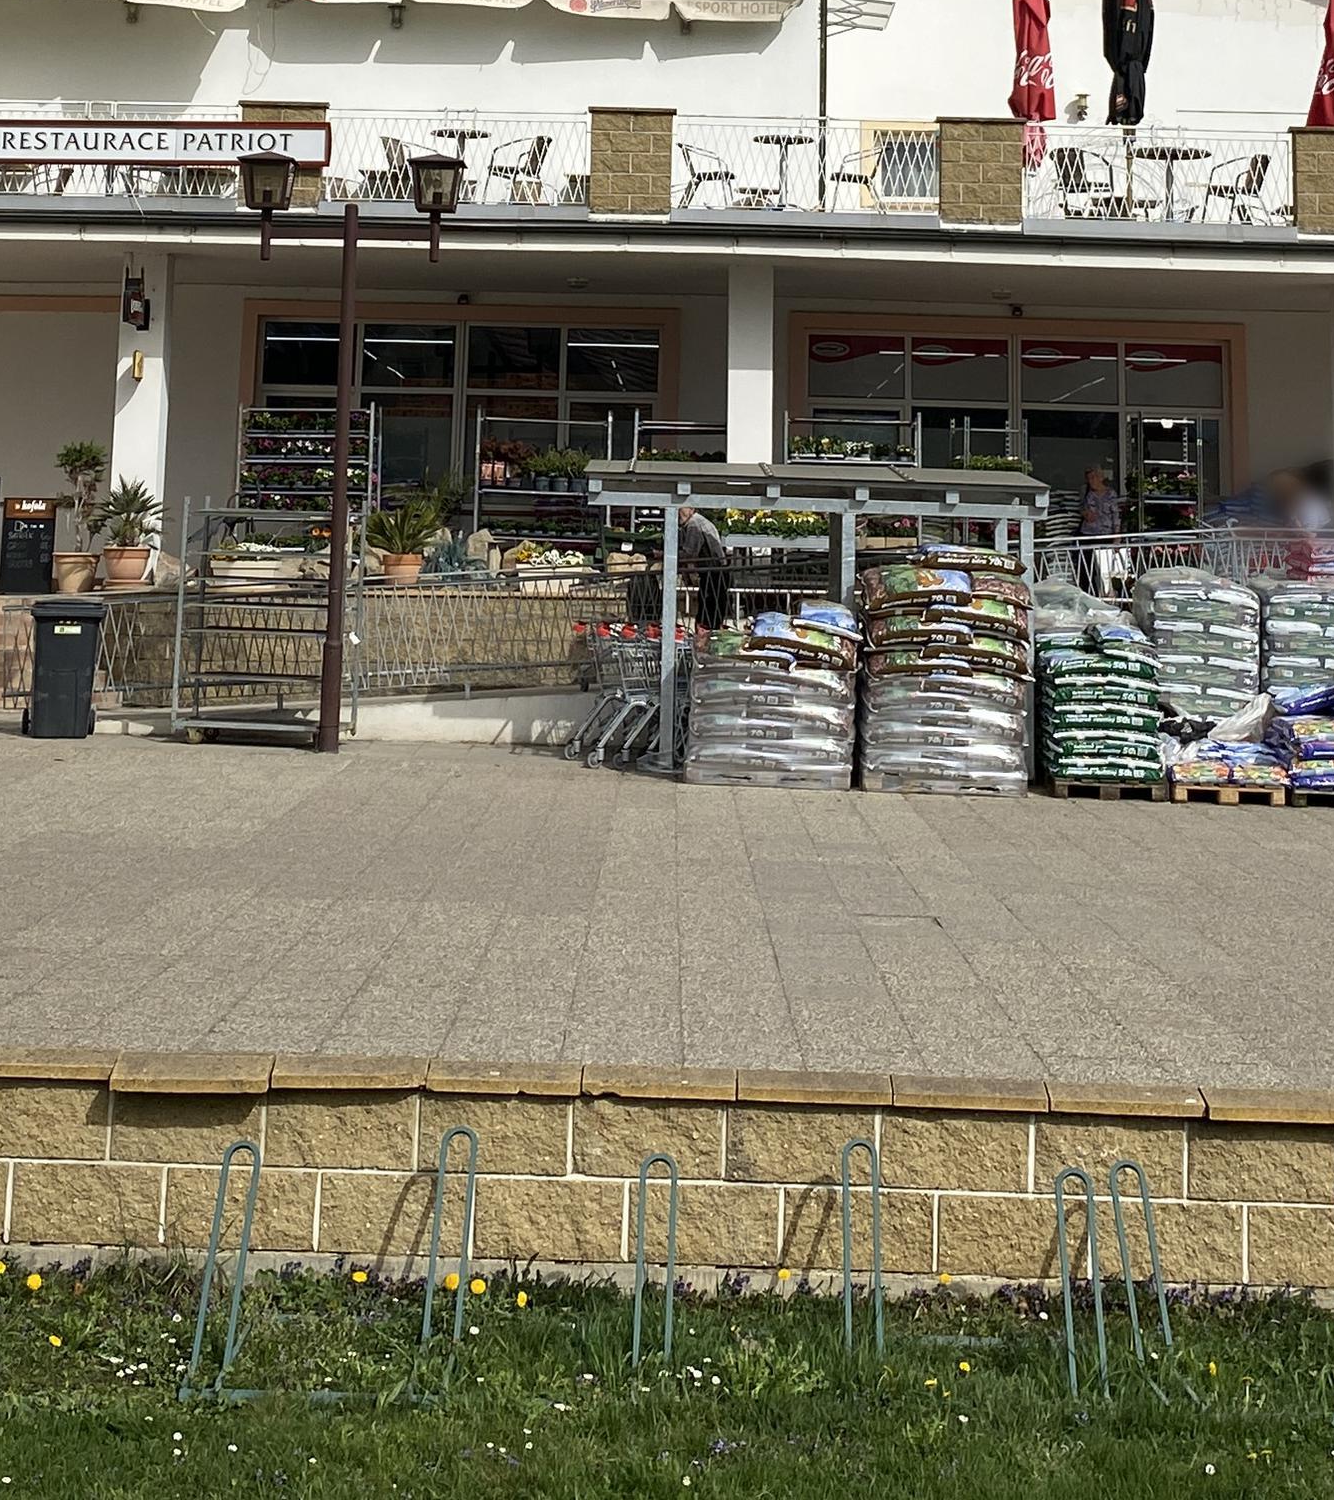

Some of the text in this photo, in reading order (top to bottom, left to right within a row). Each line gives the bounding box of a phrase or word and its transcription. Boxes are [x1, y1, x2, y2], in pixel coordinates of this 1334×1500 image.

[695, 1, 737, 14] SPORT
[1, 130, 296, 153] RESTAURACE PATRIOT
